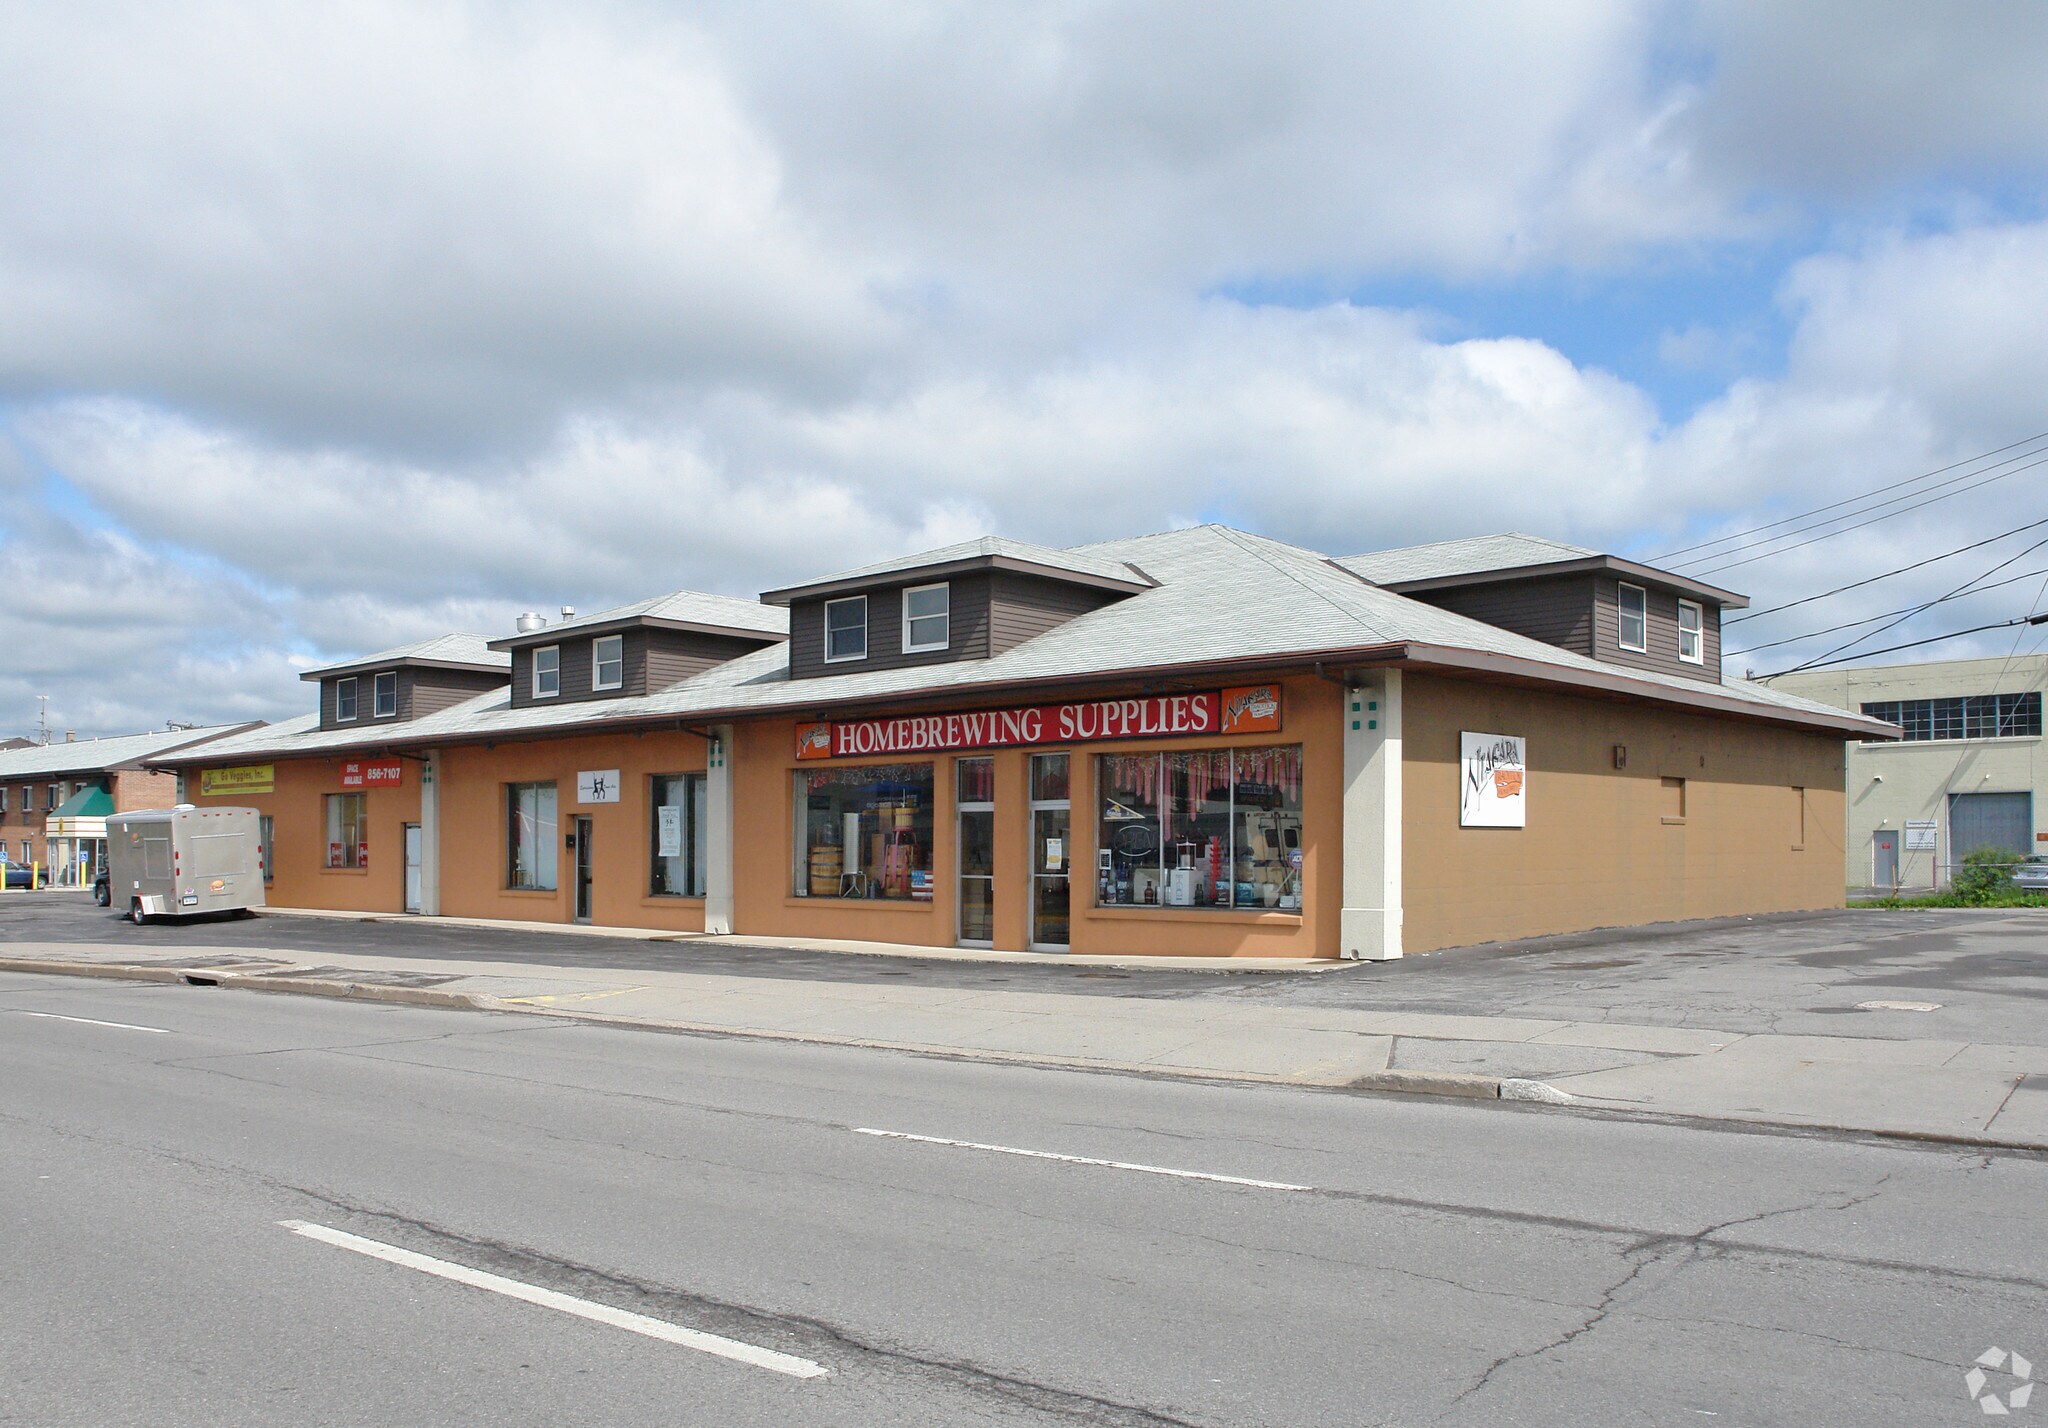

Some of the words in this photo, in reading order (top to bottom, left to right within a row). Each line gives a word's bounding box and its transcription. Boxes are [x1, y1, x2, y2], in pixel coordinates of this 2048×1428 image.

[838, 709, 1042, 755] HOMEBREWING
[1059, 695, 1209, 740] SUPPLIES
[220, 771, 229, 781] Go
[367, 767, 401, 780] 856-7107
